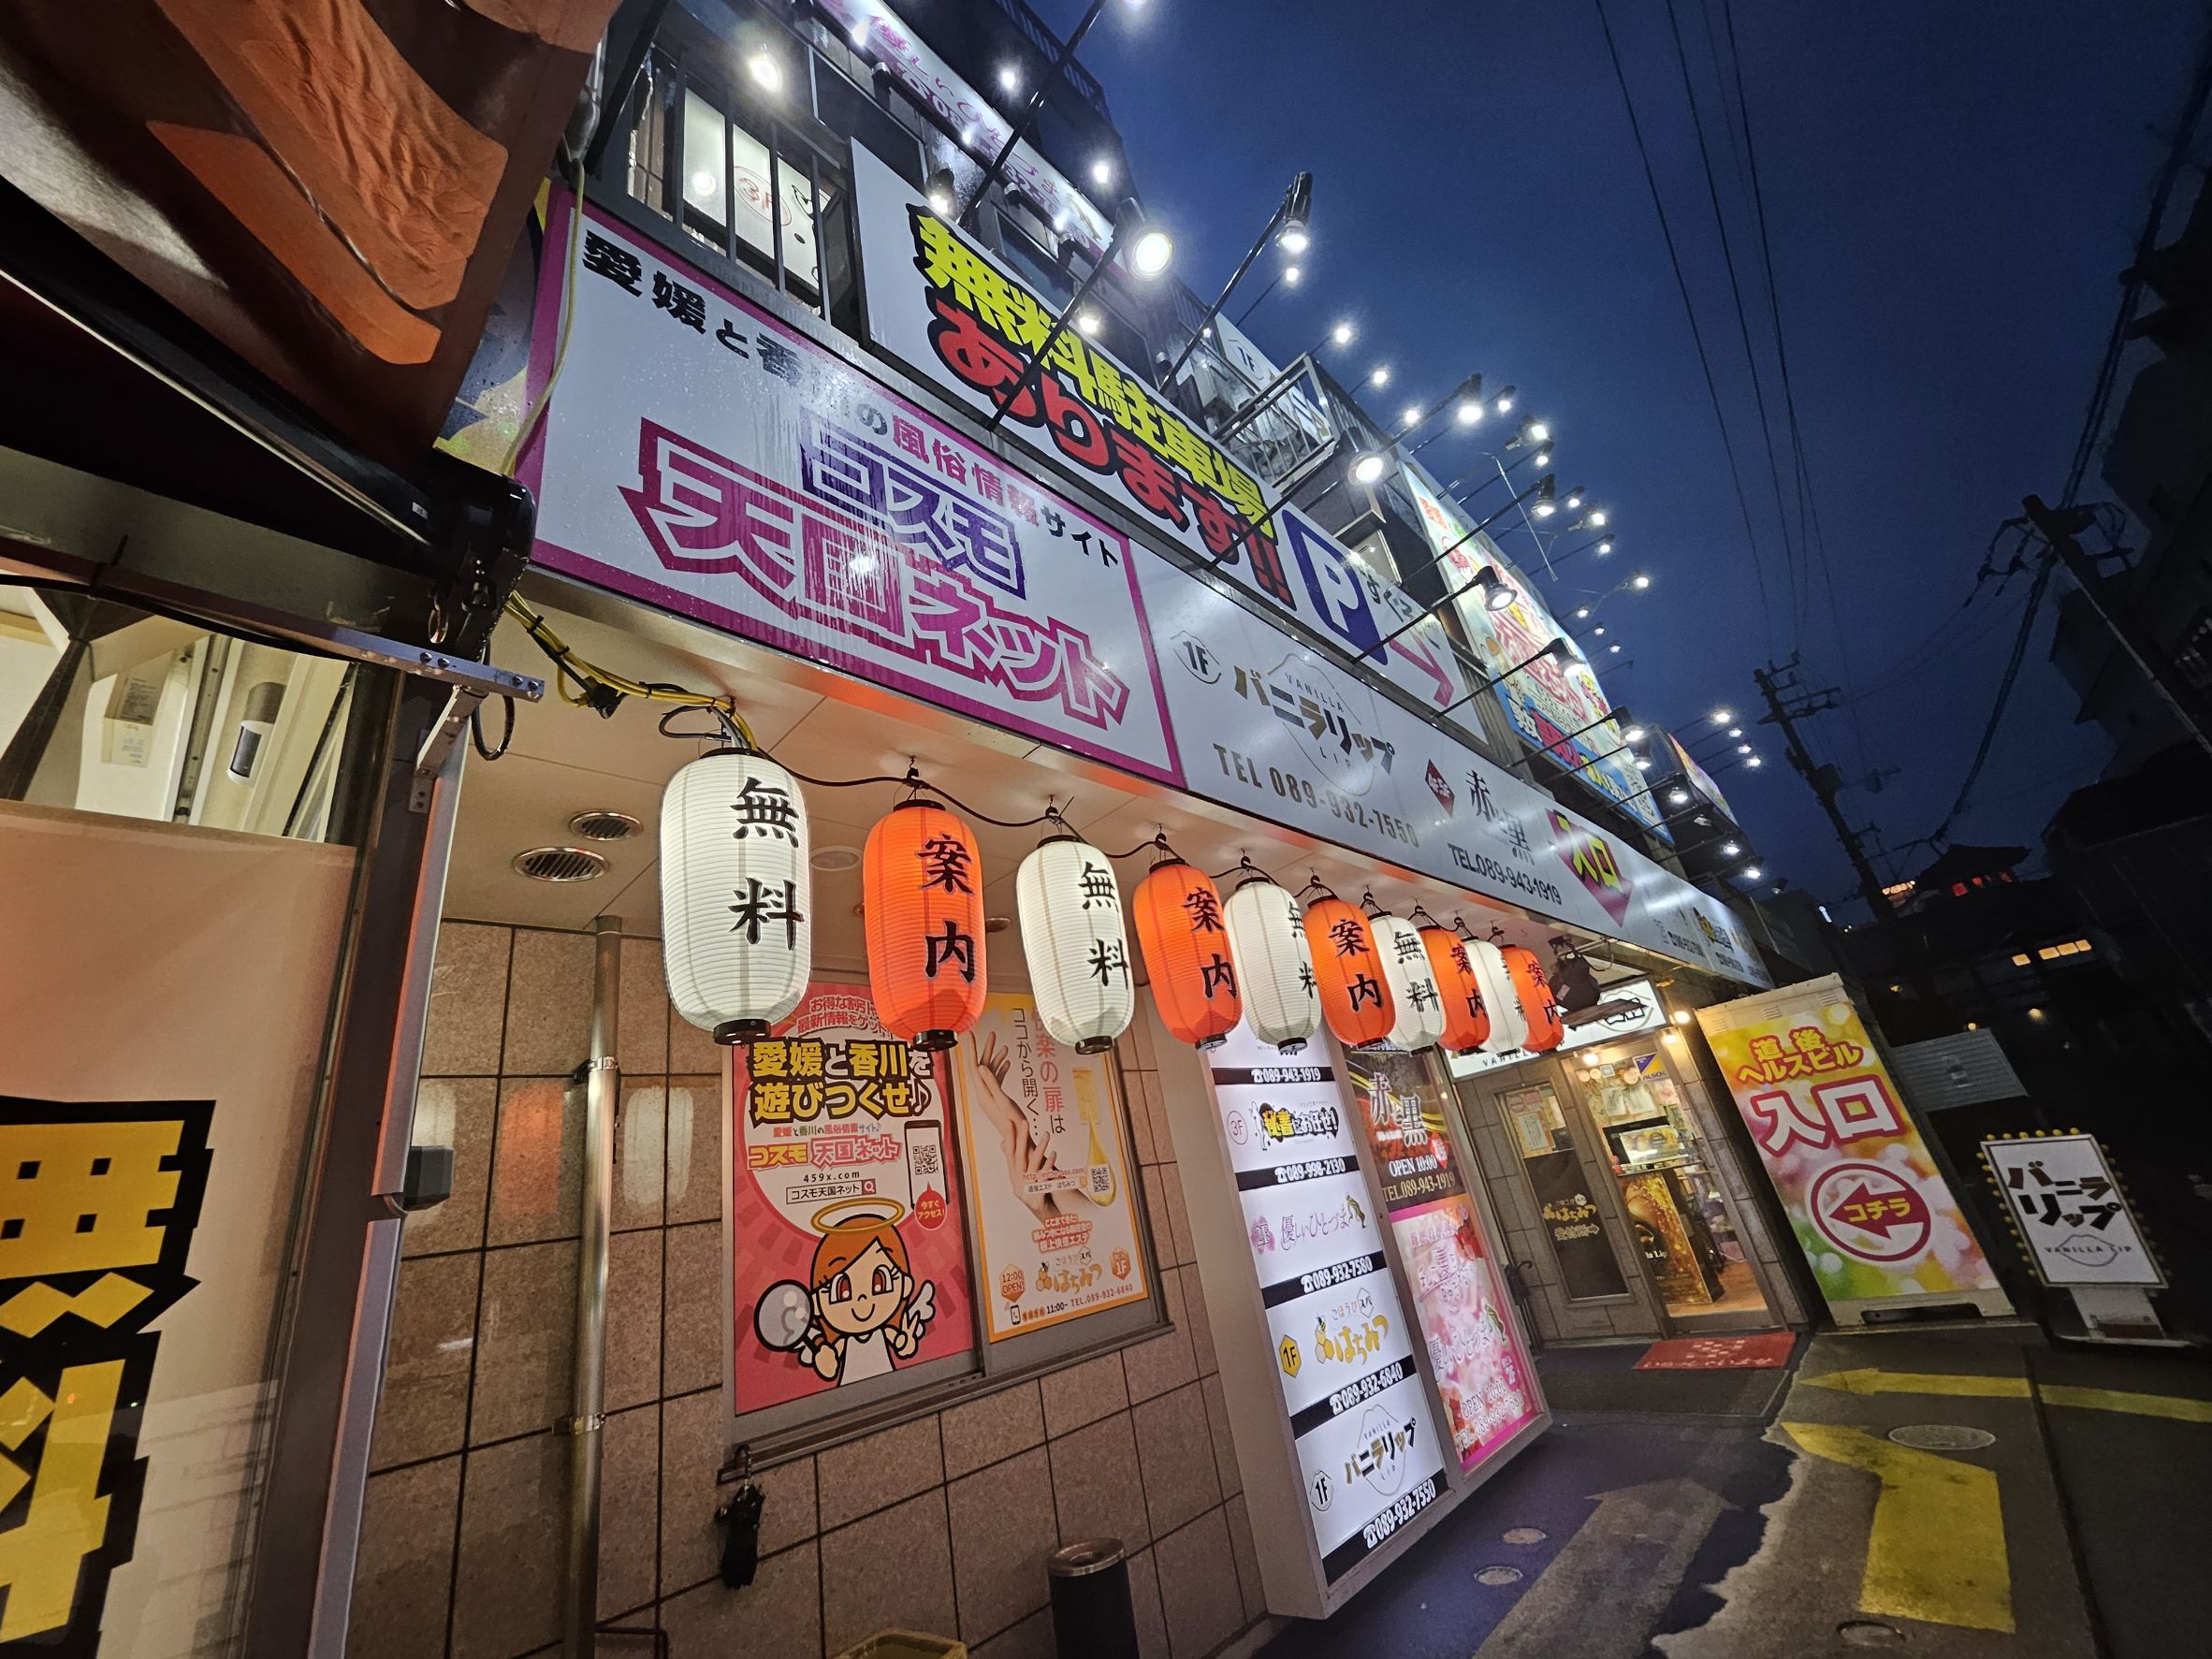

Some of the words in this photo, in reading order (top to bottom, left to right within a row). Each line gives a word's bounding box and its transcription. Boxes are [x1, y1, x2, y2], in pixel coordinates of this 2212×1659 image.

[910, 208, 1278, 543] 無料駐車場
[582, 227, 1119, 567] 愛媛と香の風俗情報サイト
[928, 286, 1297, 610] あります!!
[799, 406, 1026, 600] コスモ
[618, 416, 1130, 731] 天国ネット
[1319, 559, 1361, 634] P
[1182, 640, 1210, 677] 1F
[1284, 671, 1345, 713] VANILLA
[1232, 664, 1396, 776] バニラリップ
[1319, 746, 1354, 769] LIP
[1213, 742, 1263, 789] TEL
[1269, 766, 1420, 848] 089-932-7550
[728, 777, 806, 953] 無料
[1553, 808, 1625, 894] 入口
[918, 833, 976, 985] 案内
[1077, 861, 1129, 991] 無料
[1183, 886, 1238, 1000] 案内
[1329, 918, 1383, 1012] 案内
[1393, 930, 1441, 1013] 無料
[752, 1040, 932, 1078] 愛媛と香川を
[1482, 1049, 1535, 1067] VANILL
[1739, 1046, 1863, 1084] ヘルスビル
[1753, 1028, 1827, 1062] 道後
[1263, 1066, 1321, 1084] 089-943-1919
[1752, 1077, 1901, 1154] 入口
[749, 1142, 808, 1169] コスモ
[810, 1134, 902, 1169] 天国ネット
[1286, 1157, 1346, 1182] 089-998-2130
[1389, 1157, 1415, 1178] OPEN
[1416, 1154, 1438, 1172] 10:00
[791, 1184, 860, 1201] コスモ天国ネット
[803, 1171, 860, 1184] 459x.com
[2007, 1160, 2112, 1201] バニラ
[1842, 1197, 1913, 1224] コチラ
[2016, 1201, 2123, 1232] リップ
[1002, 1272, 1023, 1283] 12:00
[1053, 1263, 1103, 1295] はちみつ
[1312, 1255, 1374, 1290] 089-932-7580
[1283, 1345, 1298, 1369] 1F
[1333, 1315, 1390, 1365] はちみつ
[1341, 1361, 1404, 1408] 089-932-6840
[1462, 1391, 1484, 1419] OPEN
[1363, 1419, 1391, 1440] VANILLA
[1344, 1416, 1418, 1485] バニラリップ
[1315, 1476, 1329, 1506] 1F
[1375, 1477, 1437, 1541] 089-932-7550
